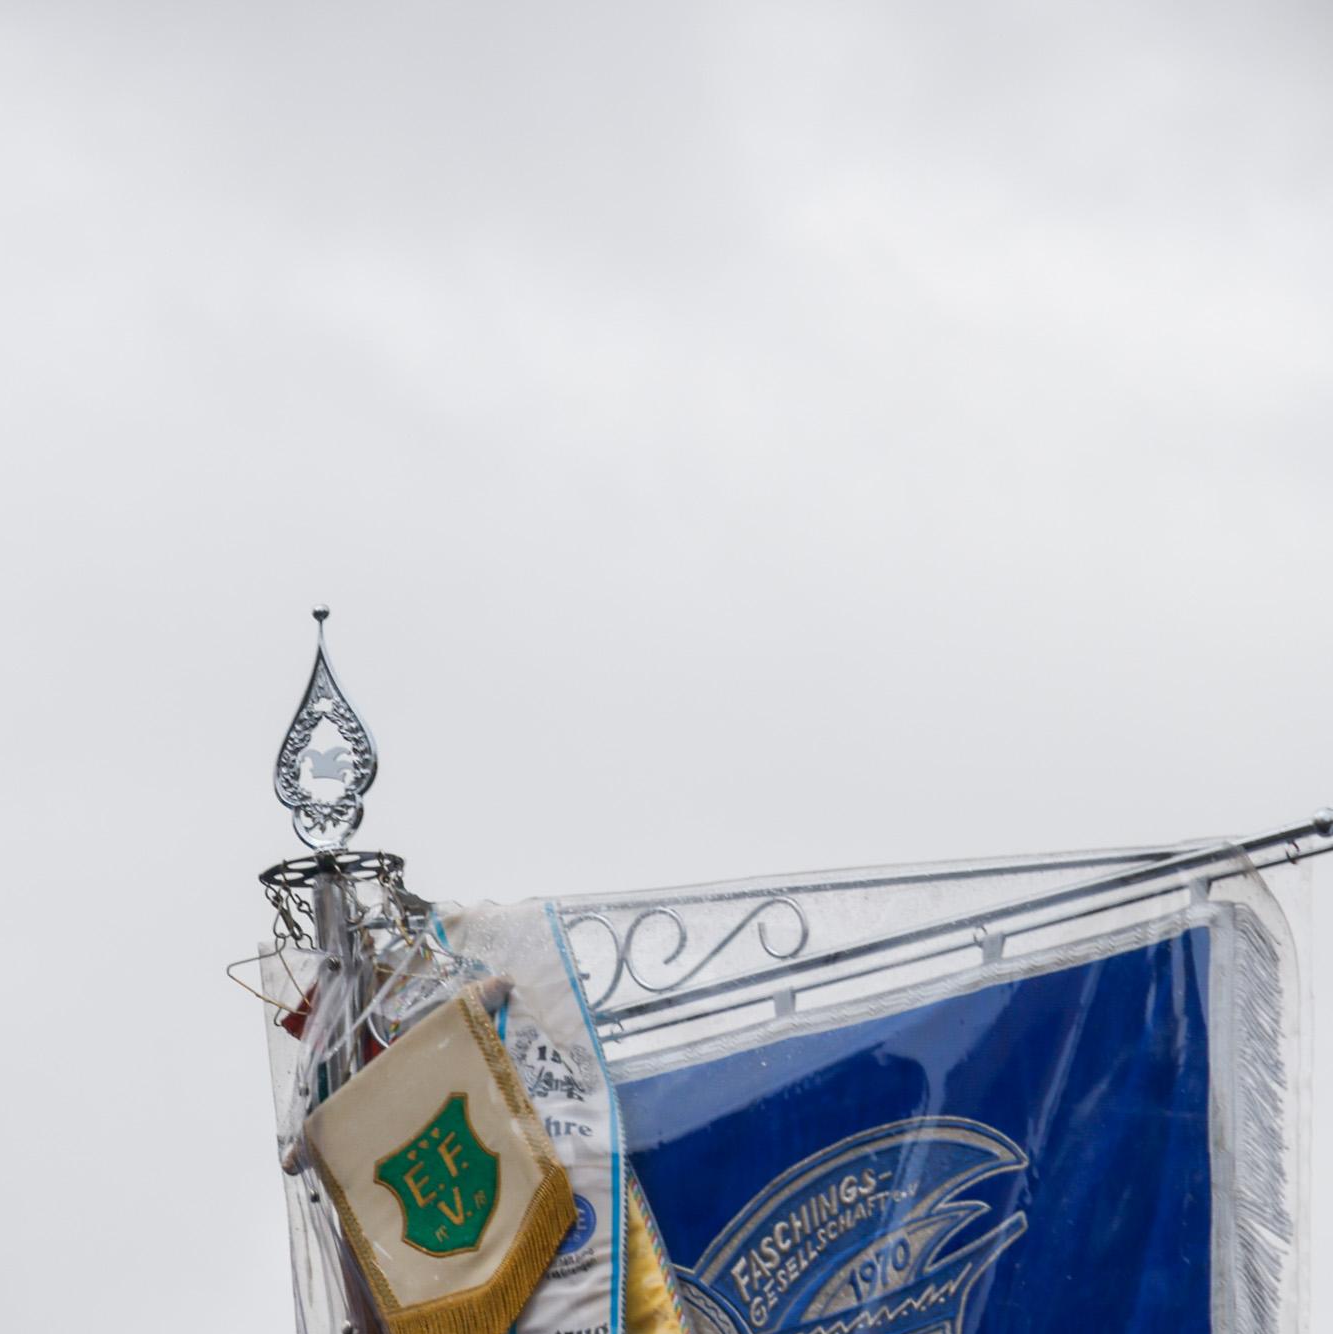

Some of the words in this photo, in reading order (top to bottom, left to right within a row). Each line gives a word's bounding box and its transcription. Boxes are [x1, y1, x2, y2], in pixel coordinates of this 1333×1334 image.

[730, 1167, 893, 1303] FASCHINGS-
[749, 1189, 890, 1328] GESELLSCHAFT
[849, 1237, 911, 1303] 1970
